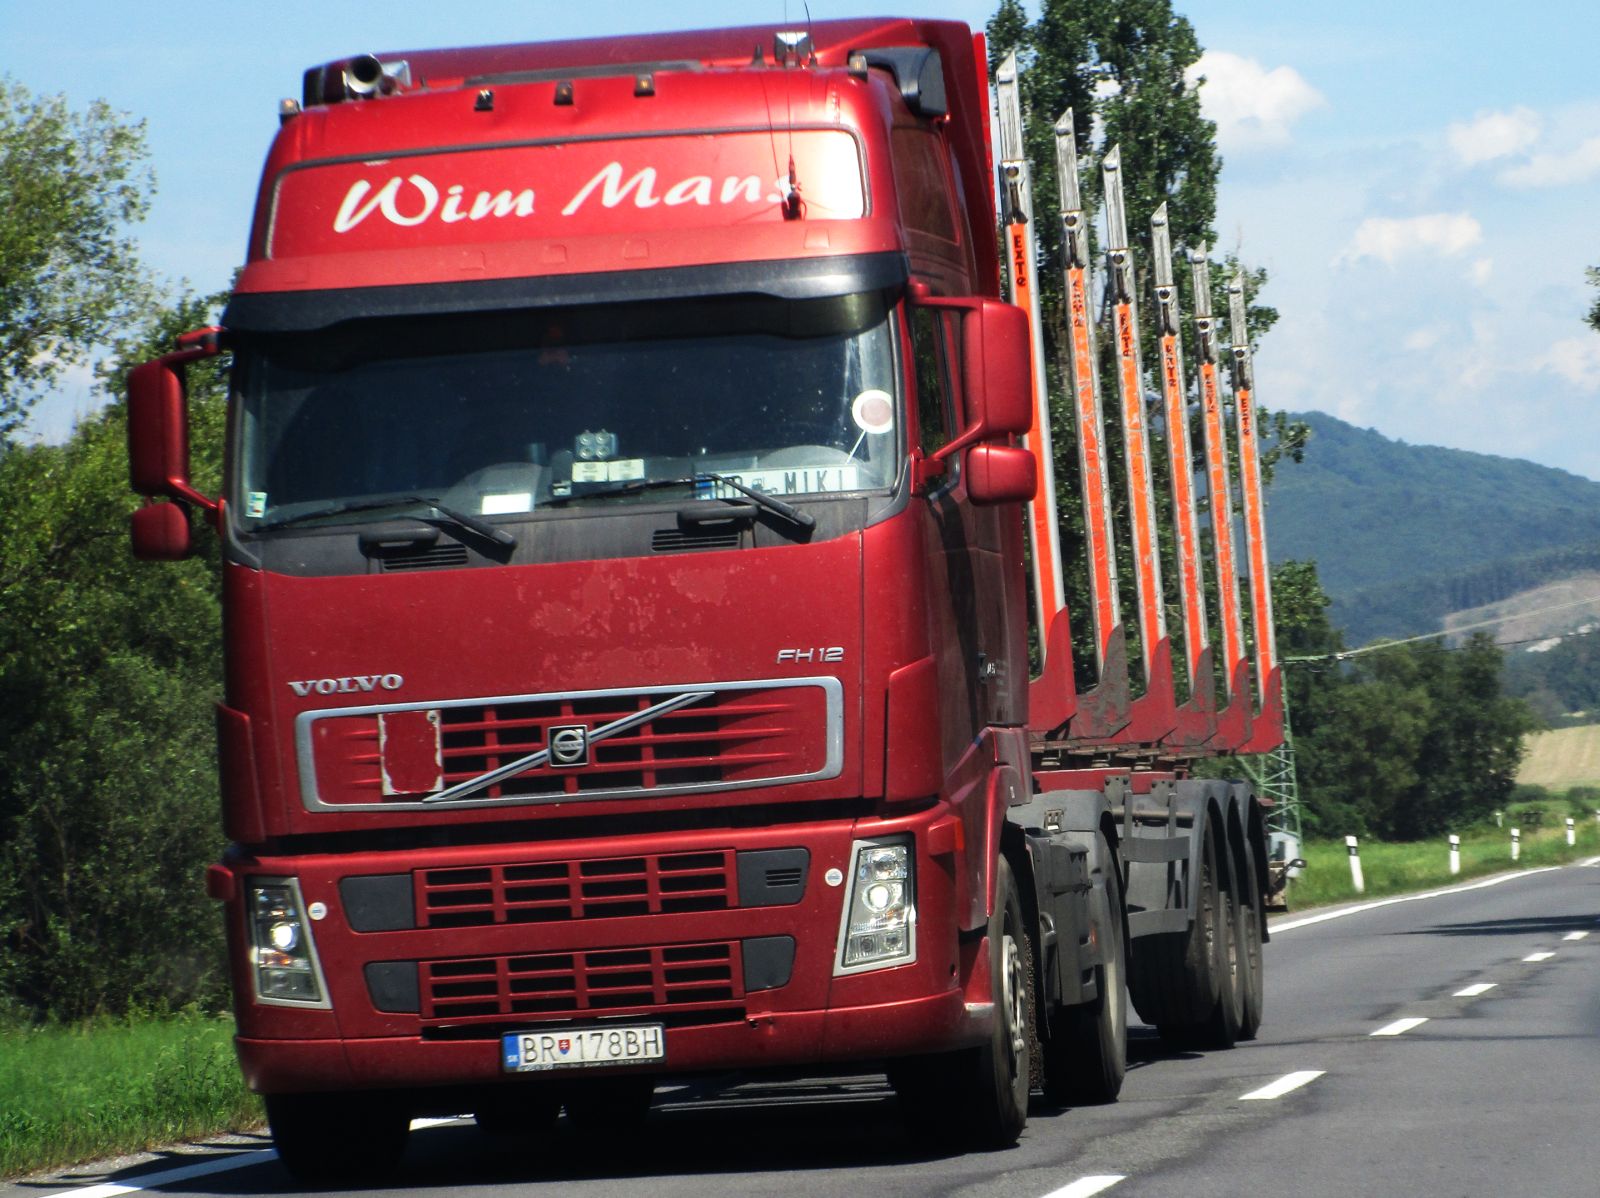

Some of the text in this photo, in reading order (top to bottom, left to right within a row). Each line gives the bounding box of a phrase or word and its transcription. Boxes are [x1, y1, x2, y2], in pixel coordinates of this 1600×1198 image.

[334, 160, 795, 233] Wim Mans
[287, 673, 404, 697] VOLVO
[523, 1028, 660, 1063] BR 178BH
